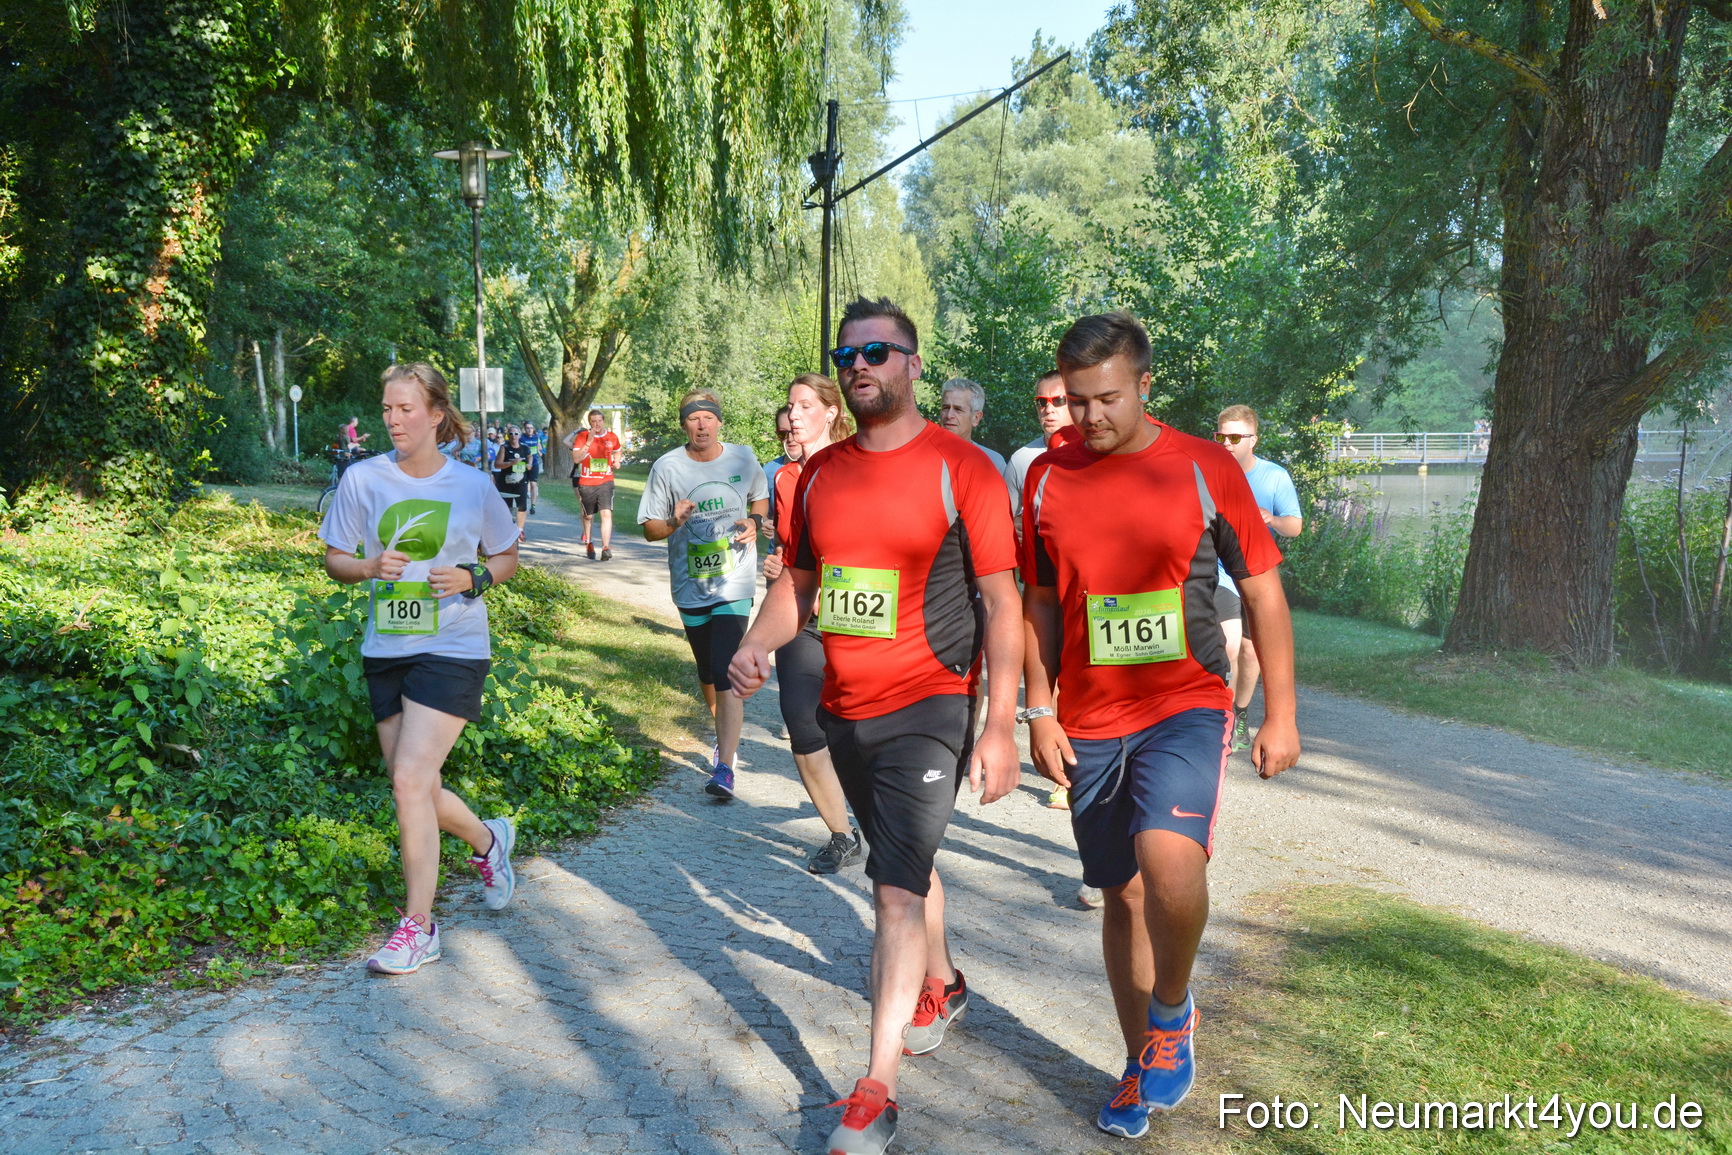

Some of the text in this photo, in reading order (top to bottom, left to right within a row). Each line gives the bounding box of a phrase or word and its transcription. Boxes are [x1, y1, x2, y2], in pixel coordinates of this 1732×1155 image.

[697, 497, 724, 512] KfH
[694, 554, 721, 569] 842
[387, 600, 421, 619] 180
[827, 589, 885, 617] 1162
[832, 615, 875, 624] Eberle Roland
[1100, 615, 1167, 644] 1161
[1113, 643, 1160, 653] Mößl Marwin
